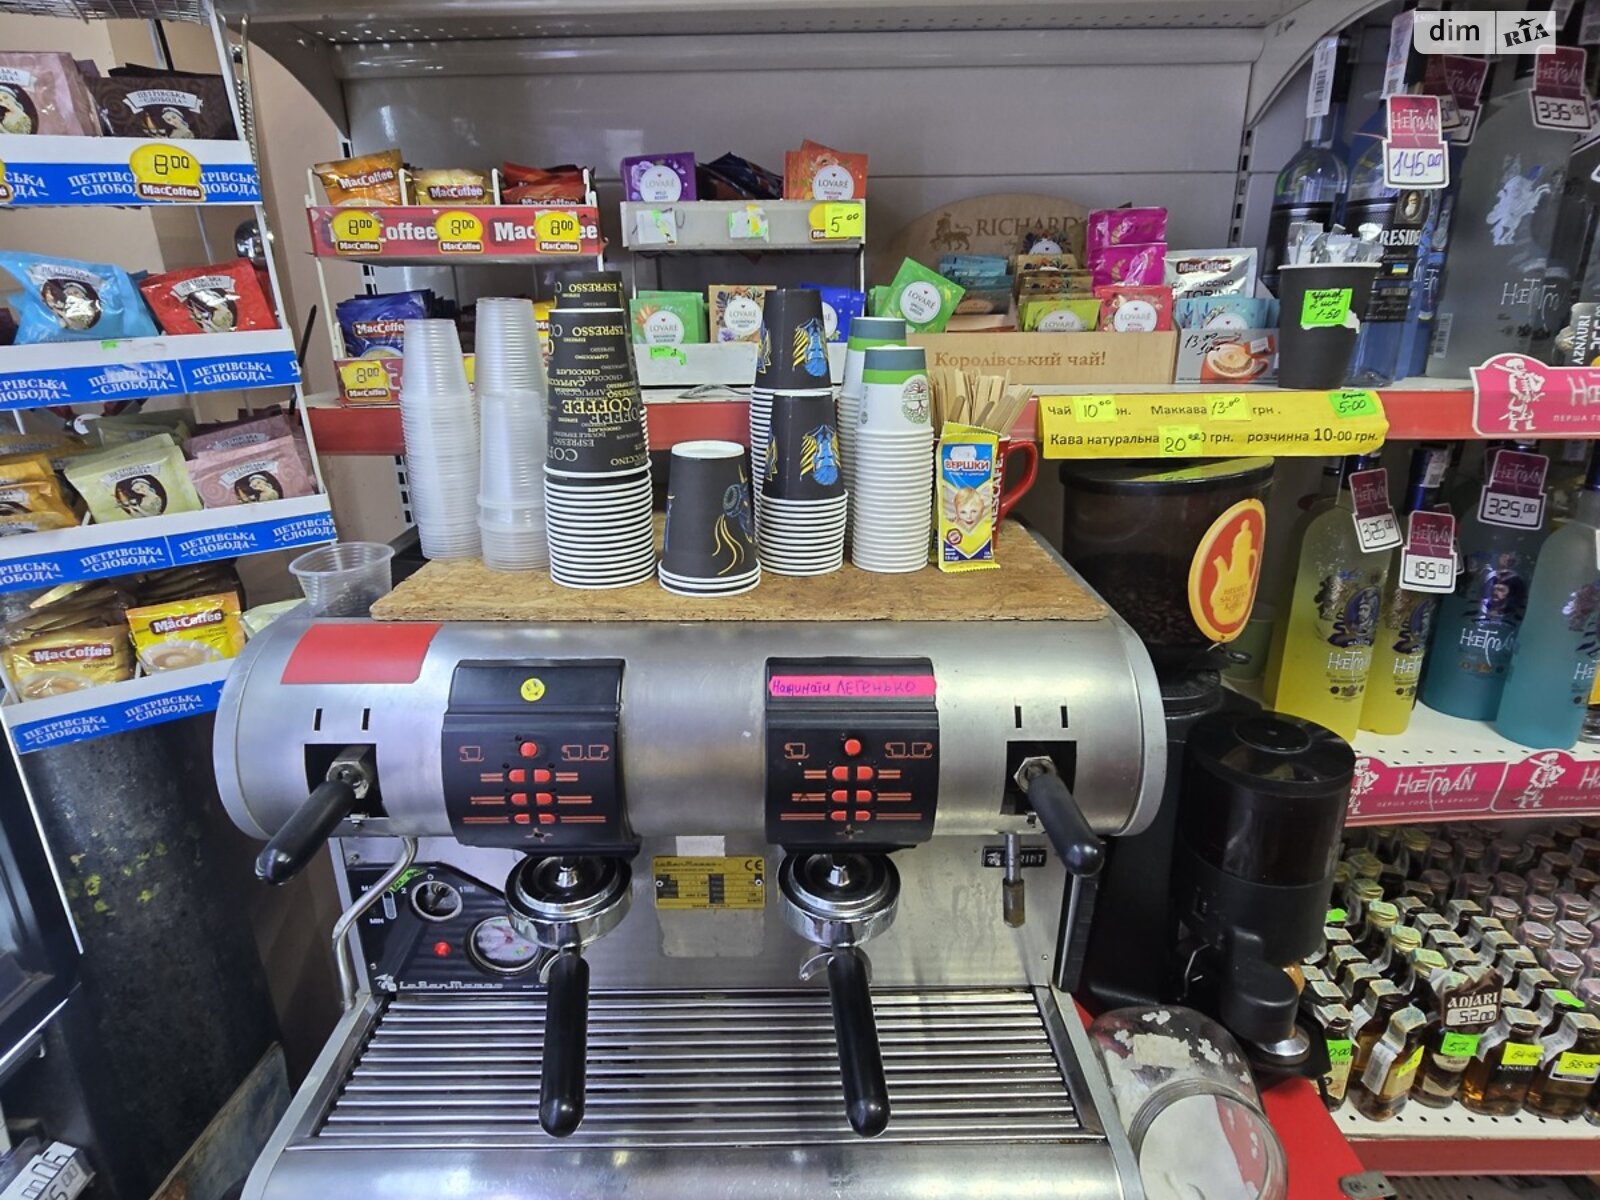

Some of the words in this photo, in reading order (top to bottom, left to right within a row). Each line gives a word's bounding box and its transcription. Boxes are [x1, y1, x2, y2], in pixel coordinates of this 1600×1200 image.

[68, 171, 137, 187] ПЕТРІВС
[340, 170, 394, 188] MacCoffee
[81, 183, 136, 197] СЛОБО
[142, 184, 200, 197] MacCoffee
[430, 187, 483, 198] MacCoffee
[340, 241, 379, 250] MacCoffee
[442, 242, 481, 250] MacCoffee
[541, 242, 578, 250] MacCoffee
[568, 282, 617, 293] ESPRESSO
[355, 322, 405, 335] MacCoffe
[571, 325, 624, 337] ESPRESSO
[935, 352, 1065, 369] Королівський
[1068, 352, 1107, 367] чай!
[191, 361, 272, 378] ПЕТРІВСЬКА
[203, 371, 266, 385] СЛОБОДА
[101, 379, 169, 395] СЛОБОДА
[561, 397, 632, 414] COFFEE
[1047, 405, 1072, 415] Чай
[1151, 405, 1208, 415] Маккава
[1337, 400, 1366, 413] 5-00
[1050, 433, 1083, 446] Кава
[1087, 434, 1160, 447] натуральна
[1210, 434, 1234, 444] грн.
[1247, 433, 1309, 445] розчинна
[1314, 428, 1352, 442] 10-00
[1354, 432, 1379, 442] грн.
[945, 460, 990, 470] ВЕРШКИ
[179, 531, 257, 551] ПЕТРІВСЬКА
[80, 546, 164, 567] ПЕТРІВСЬКА
[189, 542, 250, 557] СЛОБОДА
[92, 556, 157, 573] СЛОБОДА
[153, 611, 222, 633] MacCoffee
[33, 645, 113, 662] MacCoffee
[124, 694, 202, 718] ПЕТРІВСЬКА
[135, 702, 195, 722] СЛОБОДА
[23, 714, 107, 740] ПЕТРІВСЬКА
[36, 724, 100, 744] СЛОБОДА
[1448, 990, 1499, 1009] ADJARI
